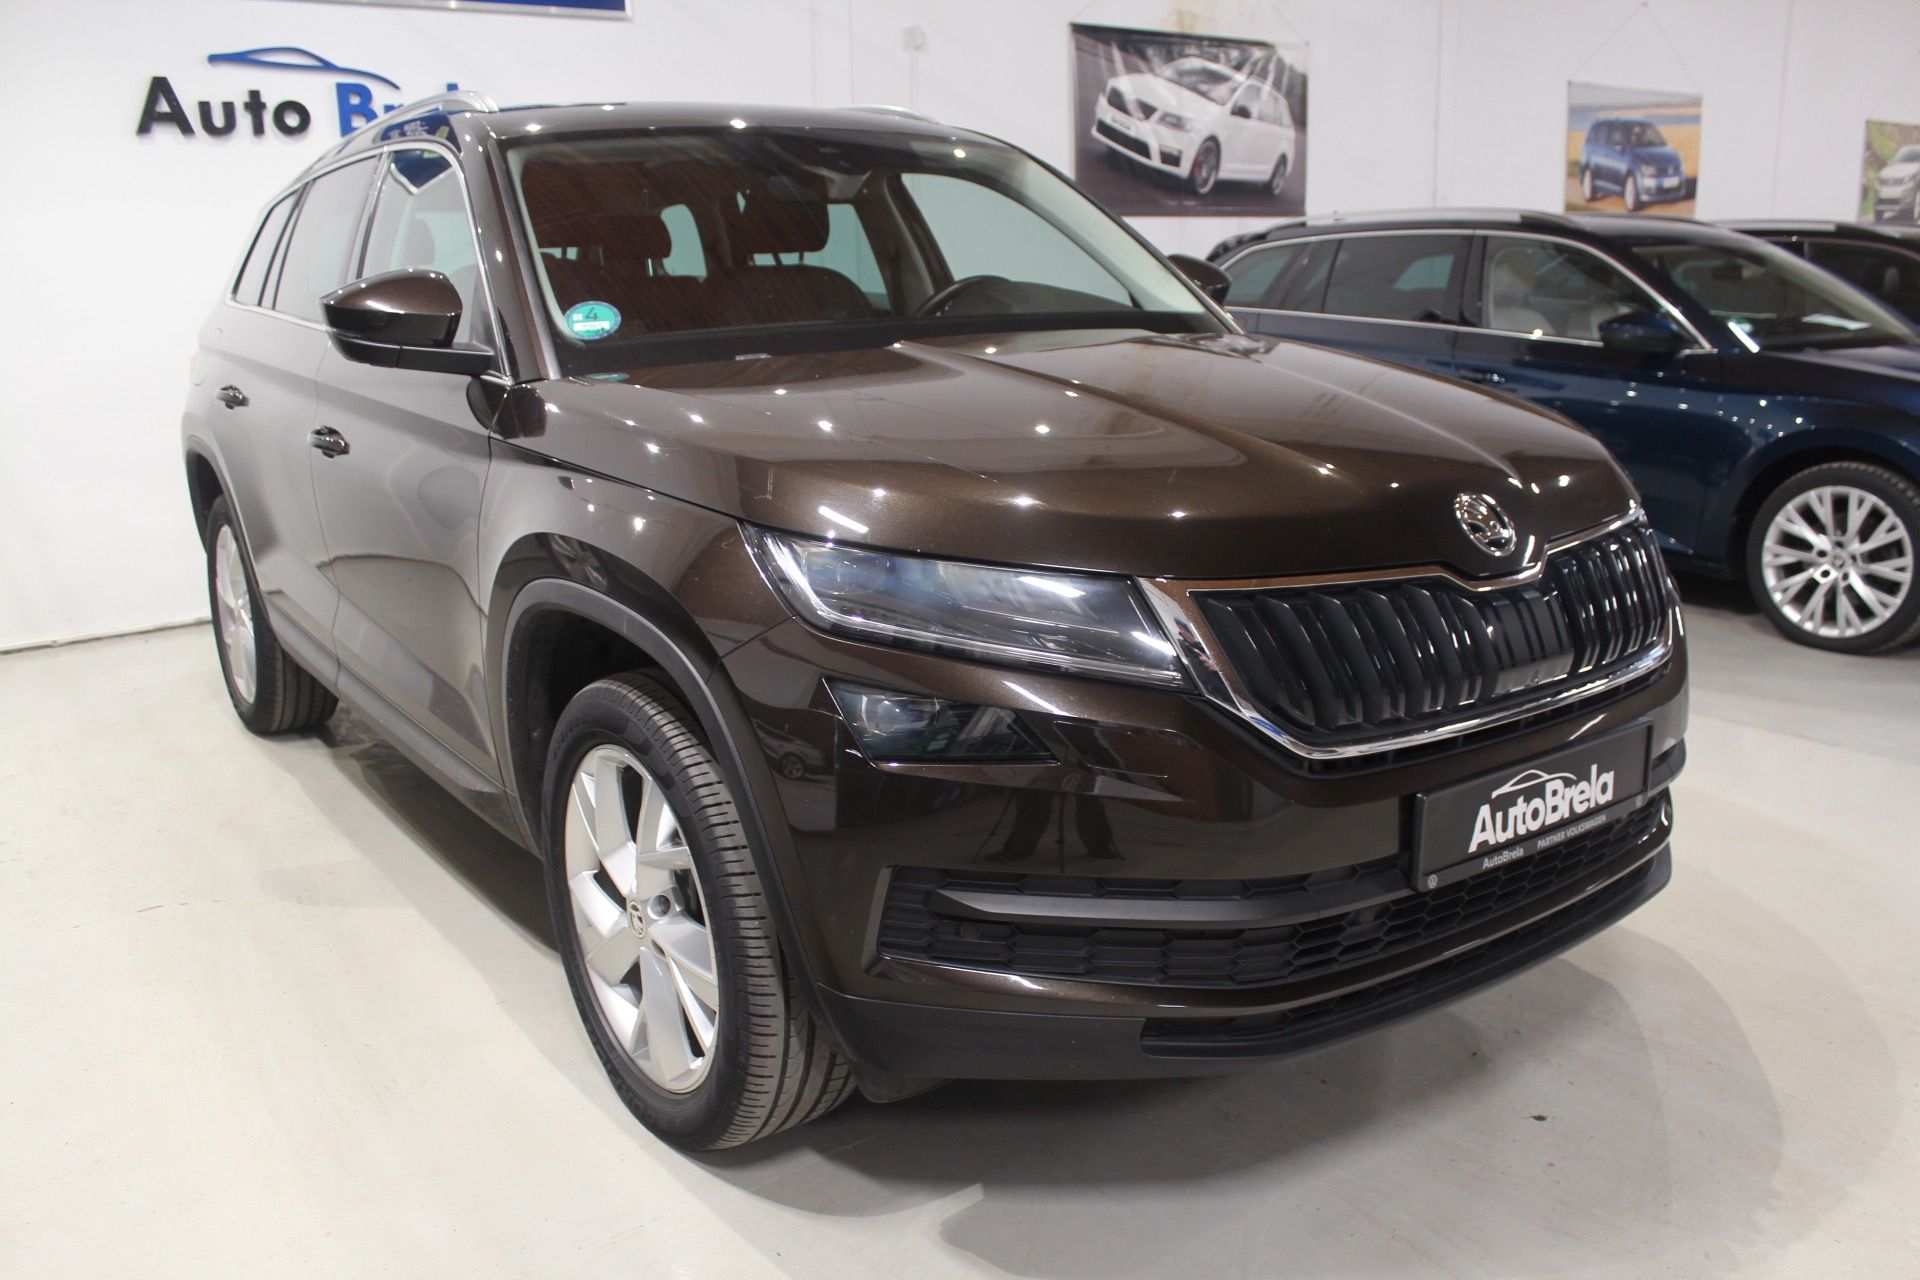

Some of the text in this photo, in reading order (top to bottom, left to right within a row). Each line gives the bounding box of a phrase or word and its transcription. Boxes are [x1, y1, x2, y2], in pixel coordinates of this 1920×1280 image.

[136, 76, 311, 136] Auto
[585, 307, 599, 321] 4
[1467, 763, 1615, 853] AutoBrela
[1482, 846, 1524, 870] AutoBrela
[1537, 830, 1566, 850] PARTNER
